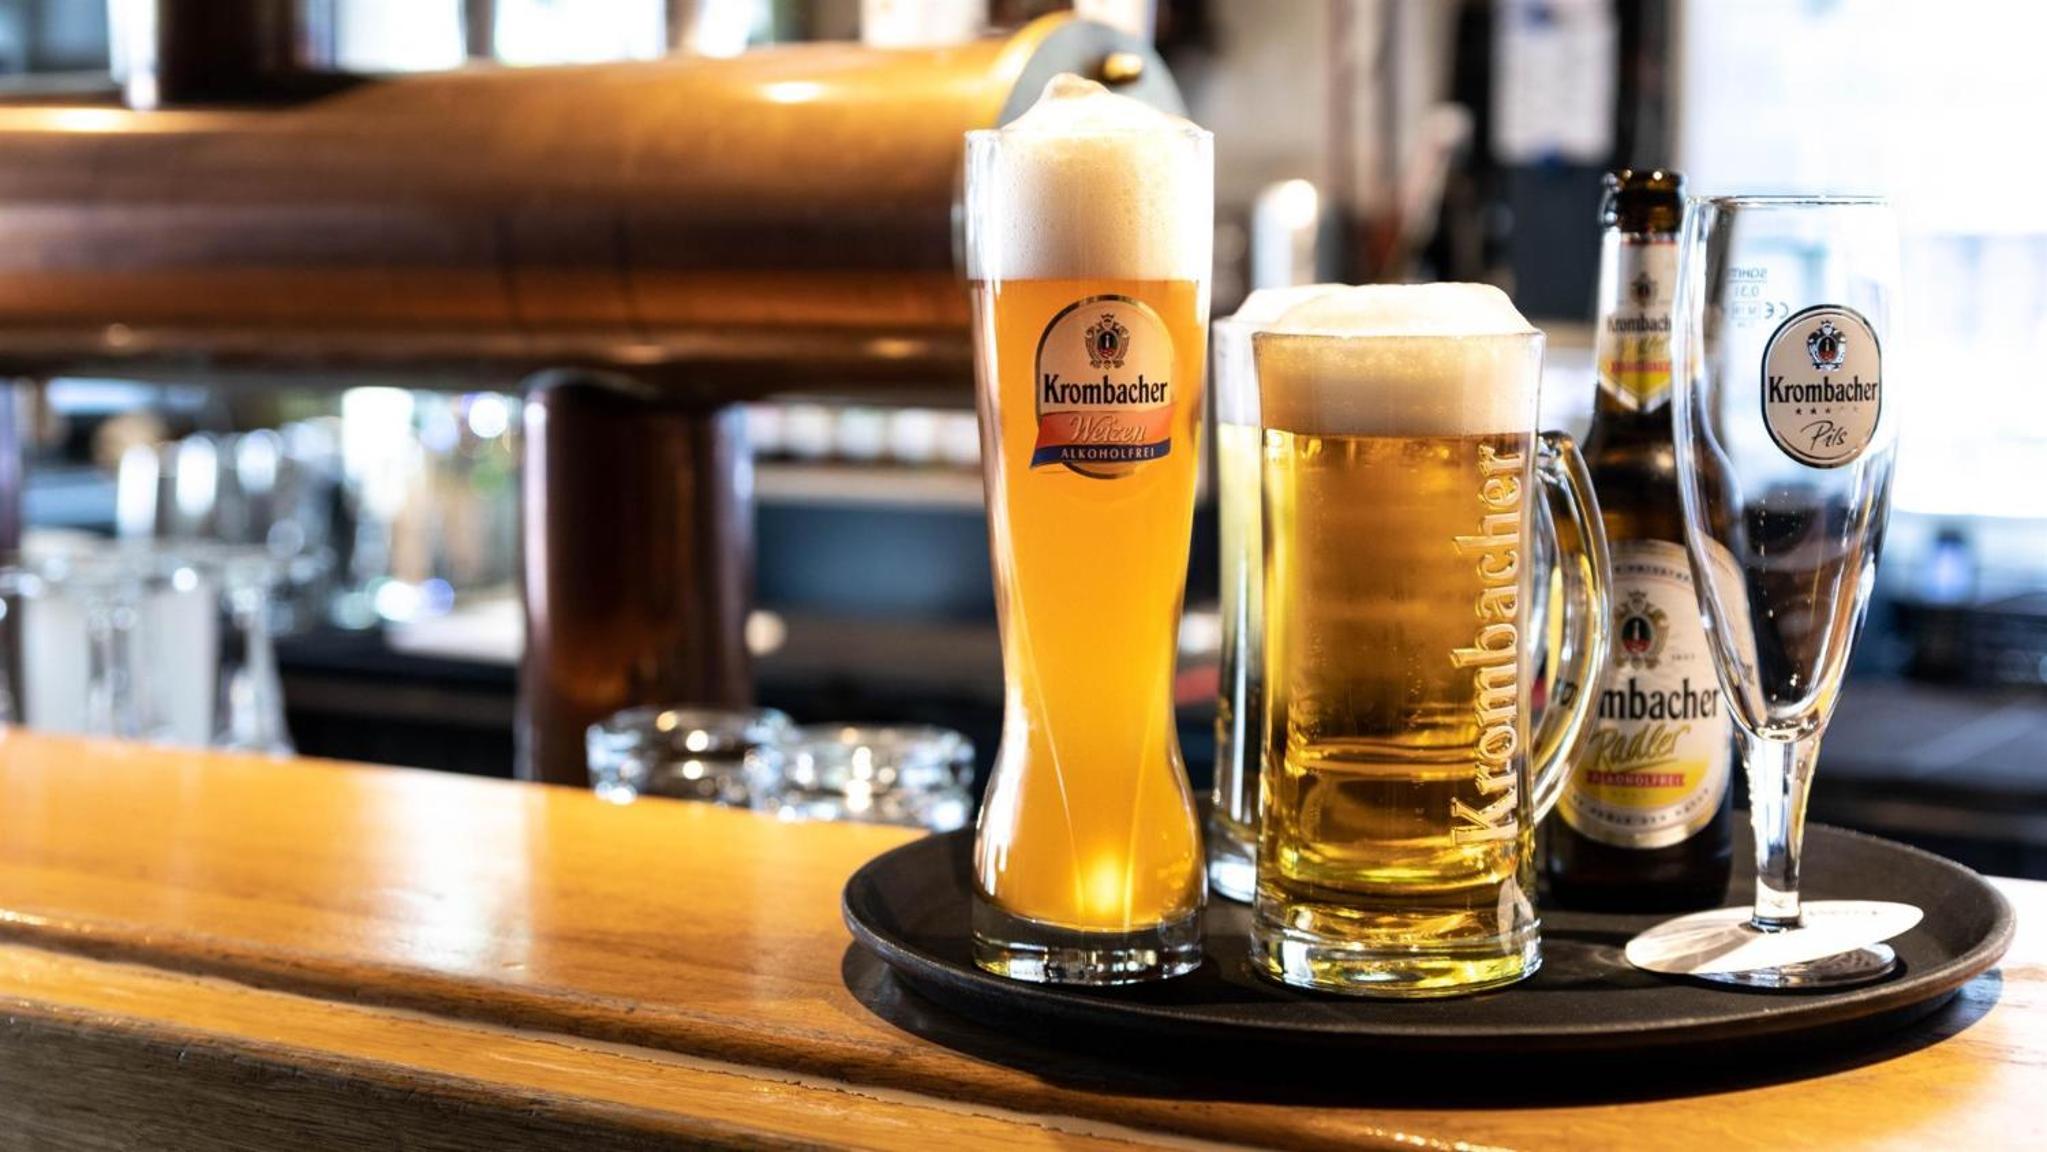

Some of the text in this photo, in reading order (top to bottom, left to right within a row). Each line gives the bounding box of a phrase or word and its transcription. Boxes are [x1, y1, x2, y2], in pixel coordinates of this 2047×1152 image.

[1044, 374, 1168, 404] Krombacher
[1769, 376, 1878, 403] Krombacher
[1069, 415, 1148, 444] Weizen
[1799, 420, 1848, 450] Pils
[1061, 447, 1155, 459] ALKOHOLFREI
[1450, 443, 1523, 844] Krombacher
[1600, 677, 1719, 719] mbacher
[1588, 723, 1691, 773] Radler
